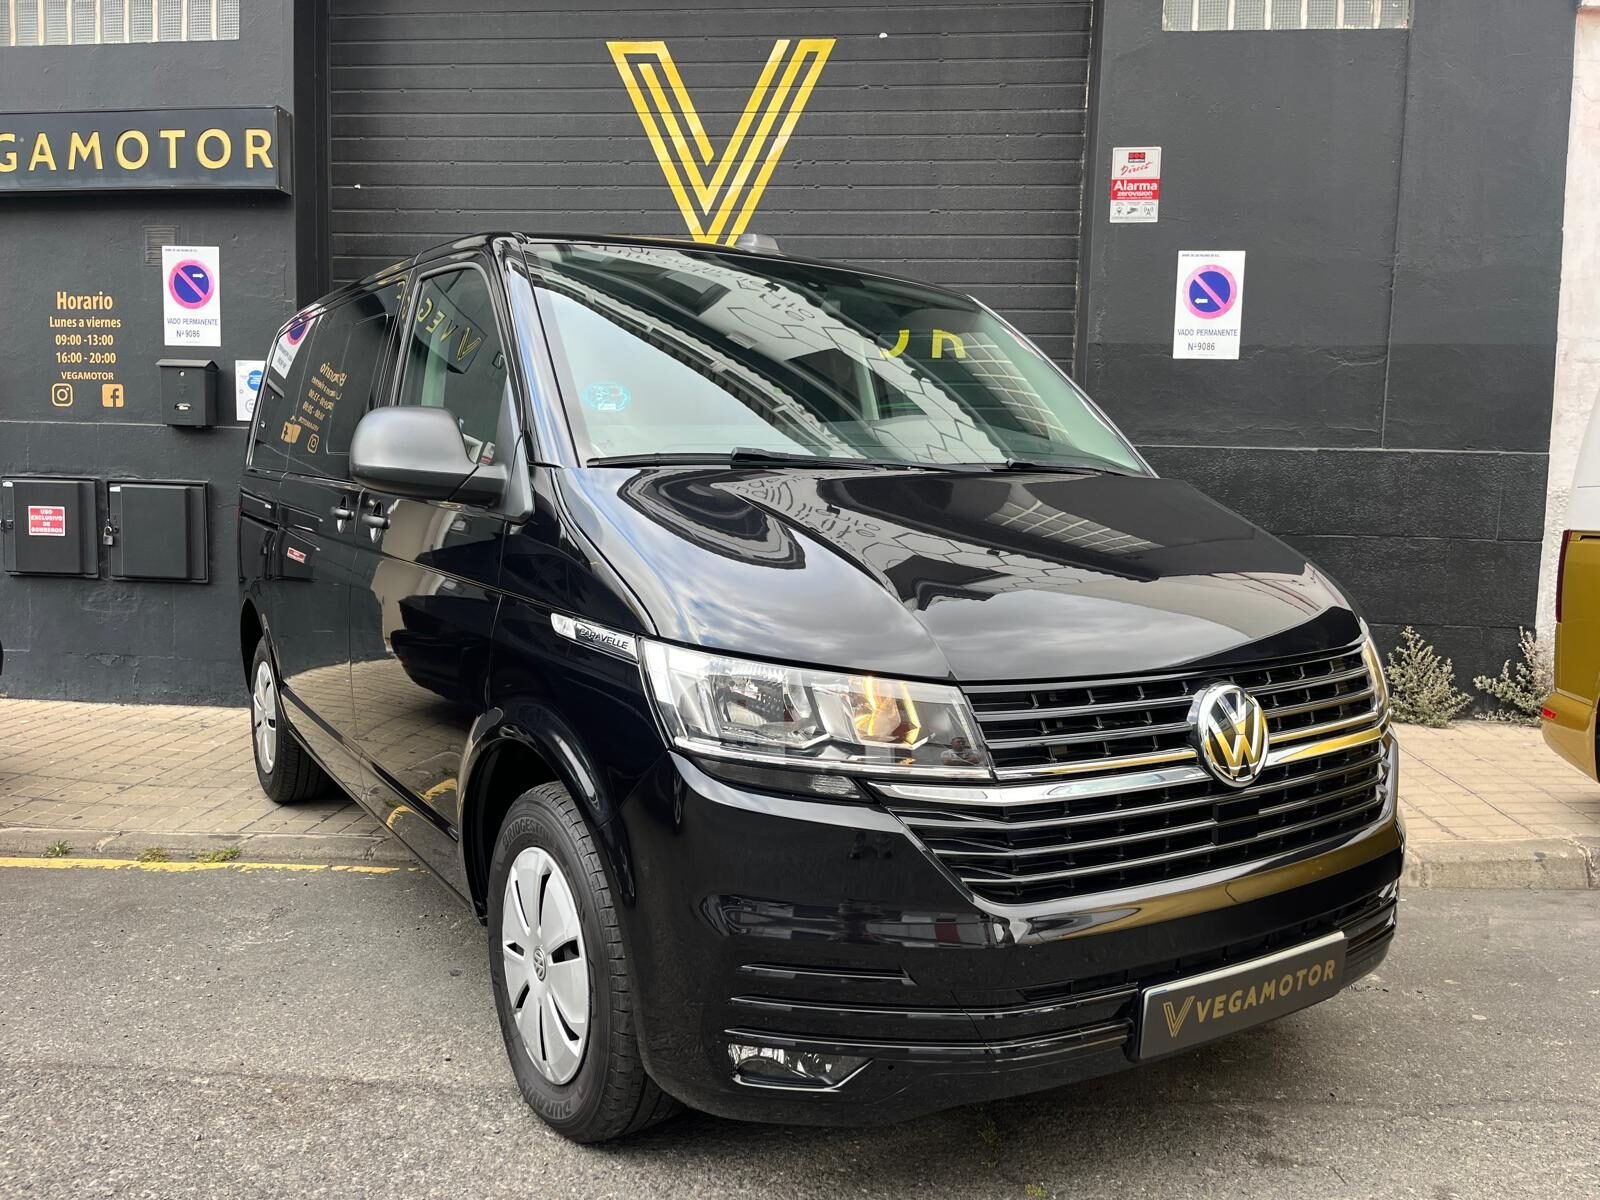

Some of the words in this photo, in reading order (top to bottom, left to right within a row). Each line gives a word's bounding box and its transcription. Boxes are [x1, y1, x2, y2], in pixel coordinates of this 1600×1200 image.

[1114, 180, 1158, 191] Alarma
[56, 291, 113, 310] Horario
[49, 316, 77, 328] Lunes
[78, 319, 85, 328] a
[86, 316, 121, 328] viernes
[167, 317, 181, 325] VADO
[182, 318, 218, 326] PERMANENTE
[1178, 328, 1194, 337] VADO
[1196, 328, 1238, 337] PERMANENTE
[55, 334, 82, 346] 09:00
[56, 352, 82, 364] 16:00
[89, 352, 117, 364] 20:00
[61, 371, 114, 381] VEGAMOTOR
[579, 627, 629, 650] CARAVELLE
[1196, 959, 1335, 1023] VEGAMOTOR
